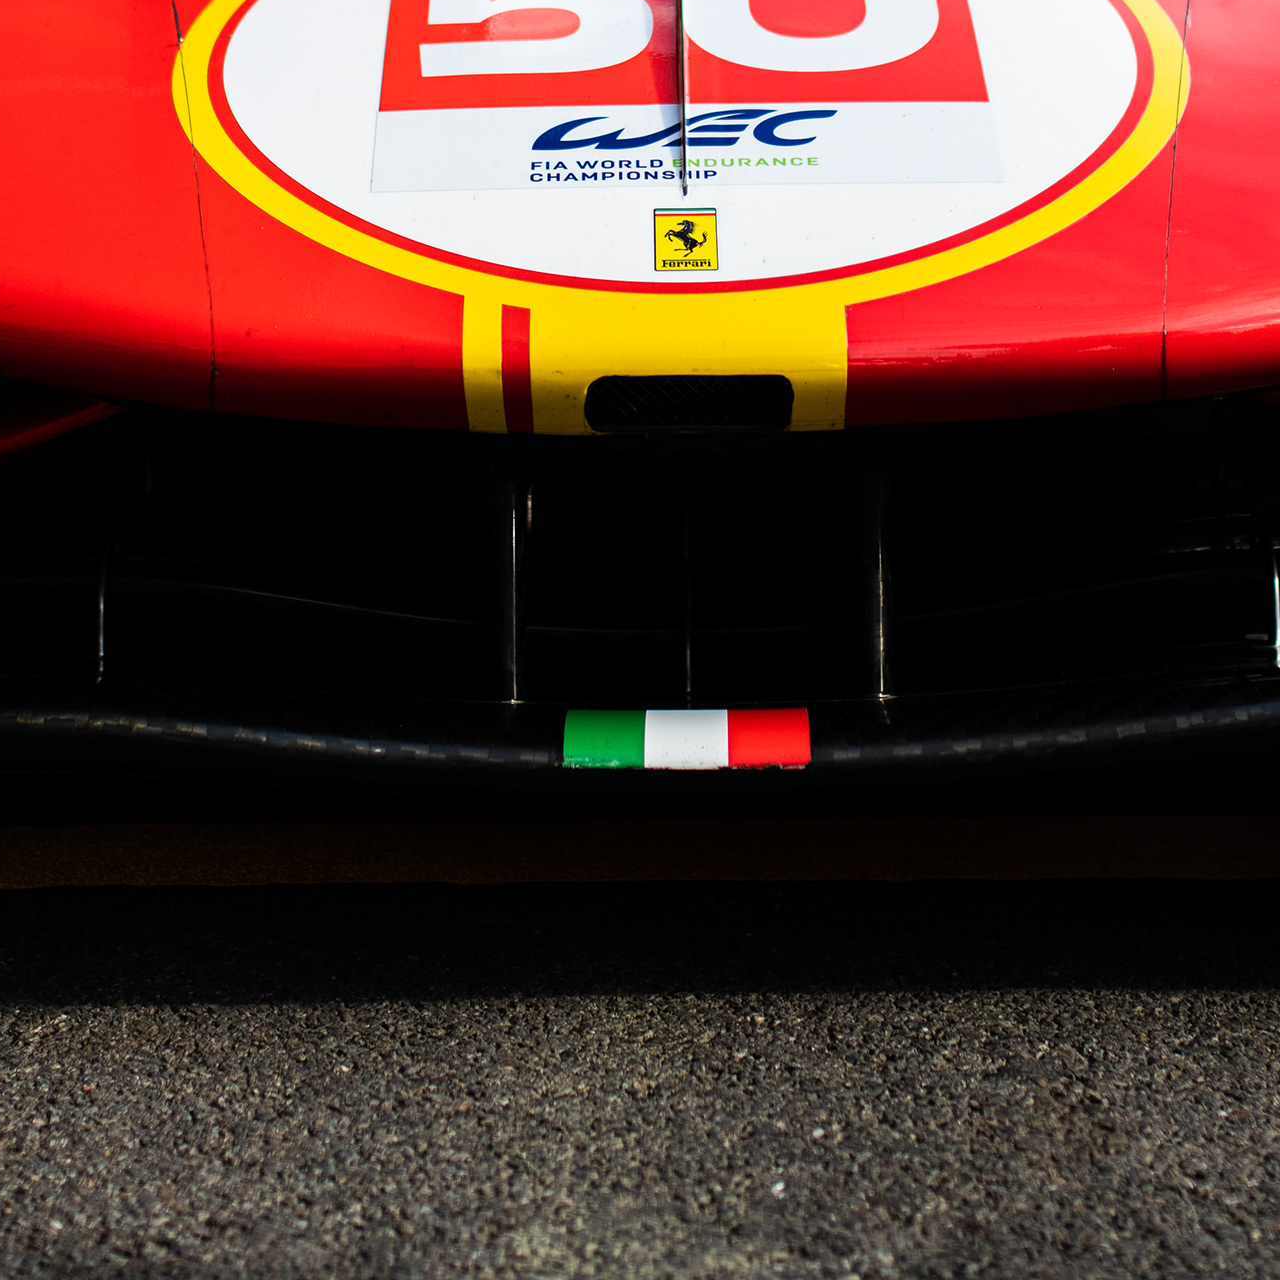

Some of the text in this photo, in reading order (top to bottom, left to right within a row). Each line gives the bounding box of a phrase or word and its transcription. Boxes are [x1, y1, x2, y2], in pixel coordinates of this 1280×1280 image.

[532, 109, 838, 151] WEC
[531, 157, 819, 170] FIA WORLD ENDURANCE
[530, 170, 718, 182] CHAMPIONSHIP
[661, 259, 712, 269] Ferrari
